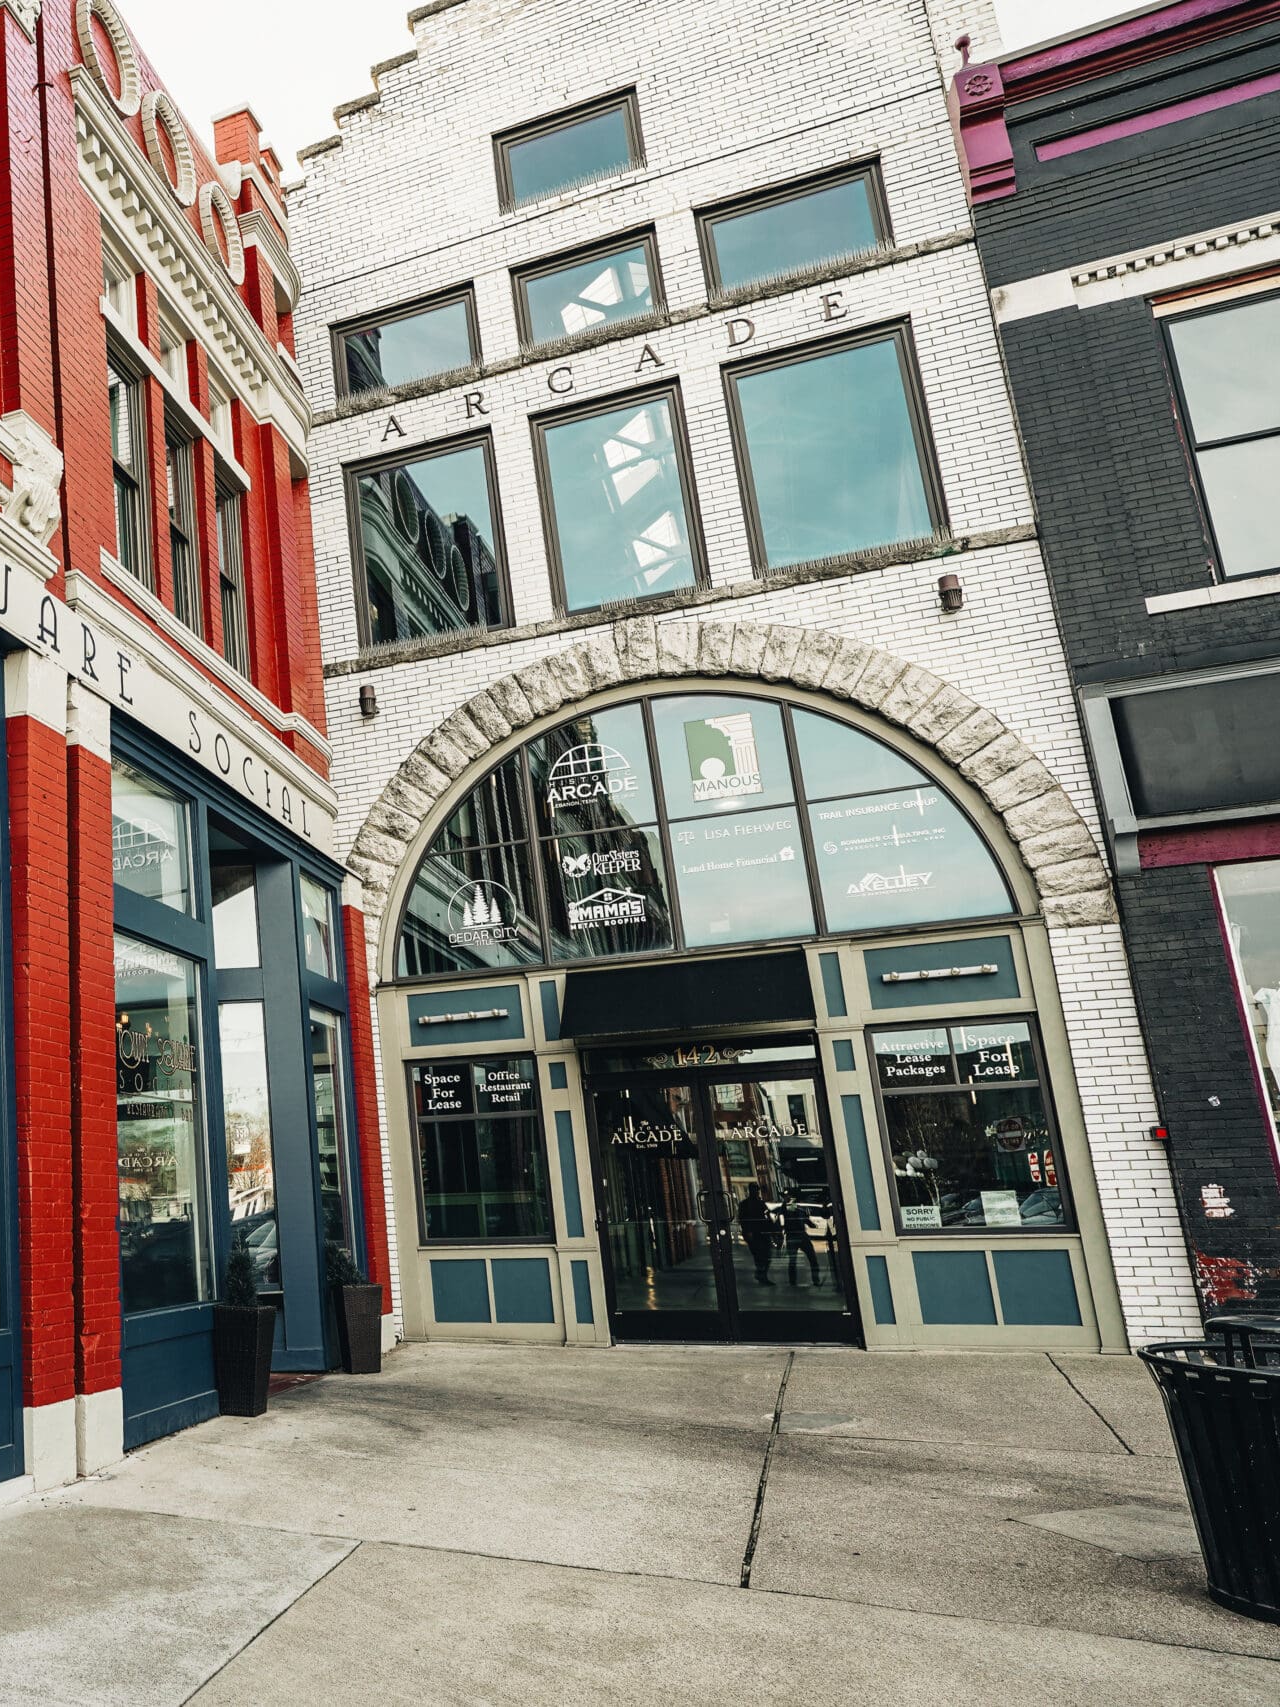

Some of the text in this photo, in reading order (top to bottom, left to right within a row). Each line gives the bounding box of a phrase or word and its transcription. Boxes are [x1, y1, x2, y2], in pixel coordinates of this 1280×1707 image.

[381, 291, 848, 441] ARCADE
[189, 711, 311, 838] SOCIAL
[547, 775, 639, 803] ARCADE
[693, 773, 761, 793] MANOUS
[818, 797, 938, 821] TRAIL INSURANCE GROUP
[704, 828, 730, 841] LISA
[593, 858, 641, 876] KEEPER
[682, 854, 778, 874] Land Home Financial
[570, 916, 646, 930] METAL ROOFING
[448, 925, 520, 944] CEDAR CITY
[475, 938, 495, 947] TITLE
[880, 1039, 944, 1052] Attractive
[967, 1034, 1015, 1049] Space
[117, 1027, 197, 1075] TOWN SQUARE
[675, 1046, 717, 1067] 142
[978, 1050, 1010, 1063] For
[896, 1053, 932, 1064] Lease
[487, 1071, 520, 1081] Office
[886, 1064, 946, 1077] Packages
[974, 1063, 1020, 1077] Lease
[424, 1073, 461, 1087] Space
[479, 1081, 532, 1092] Restaurant
[432, 1088, 455, 1099] For
[491, 1092, 520, 1103] Retail
[427, 1099, 462, 1110] Lease
[611, 1129, 683, 1144] ARCADE
[731, 1123, 807, 1139] ARCADE
